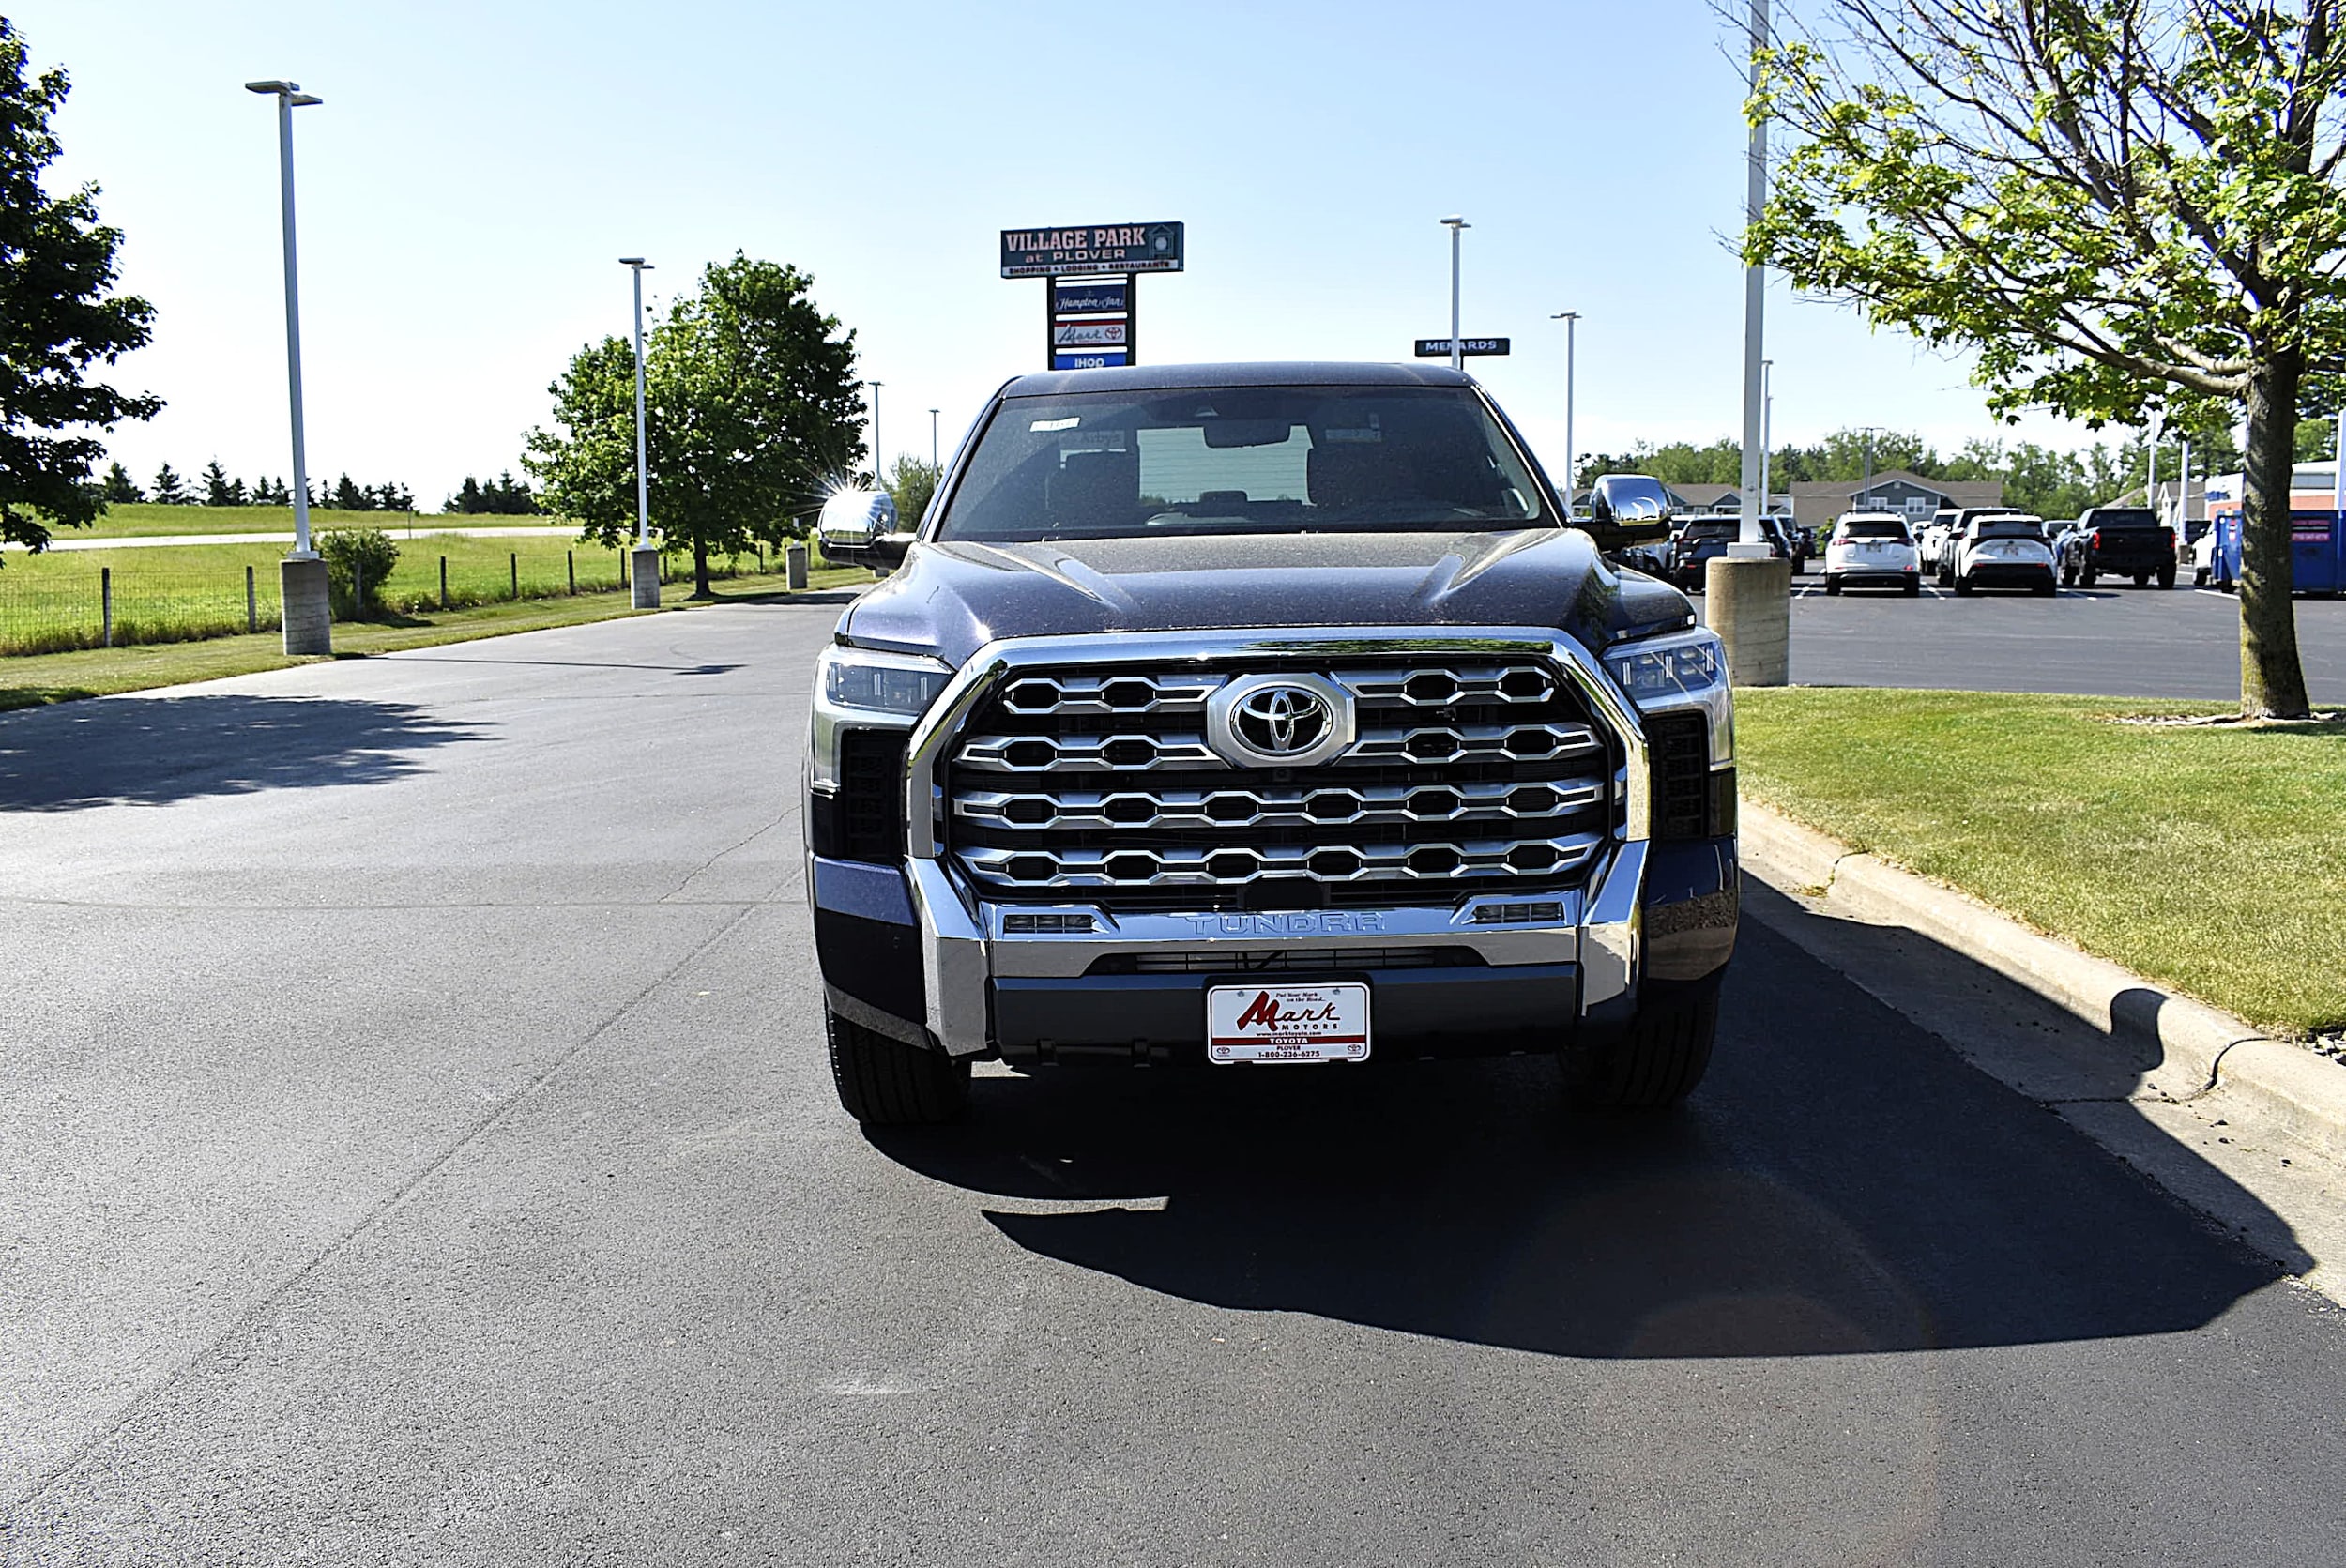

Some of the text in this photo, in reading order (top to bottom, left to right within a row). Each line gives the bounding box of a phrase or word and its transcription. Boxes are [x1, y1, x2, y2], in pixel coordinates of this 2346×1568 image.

[1006, 227, 1146, 251] VILLAGE PARK
[1025, 249, 1126, 264] at PLOVER
[1061, 264, 1098, 272] LODGING
[1109, 261, 1170, 270] RESTAURANTS
[1055, 296, 1124, 311] Hampton Inn
[1185, 912, 1387, 934] TUNDRA
[1237, 991, 1340, 1031] Mark
